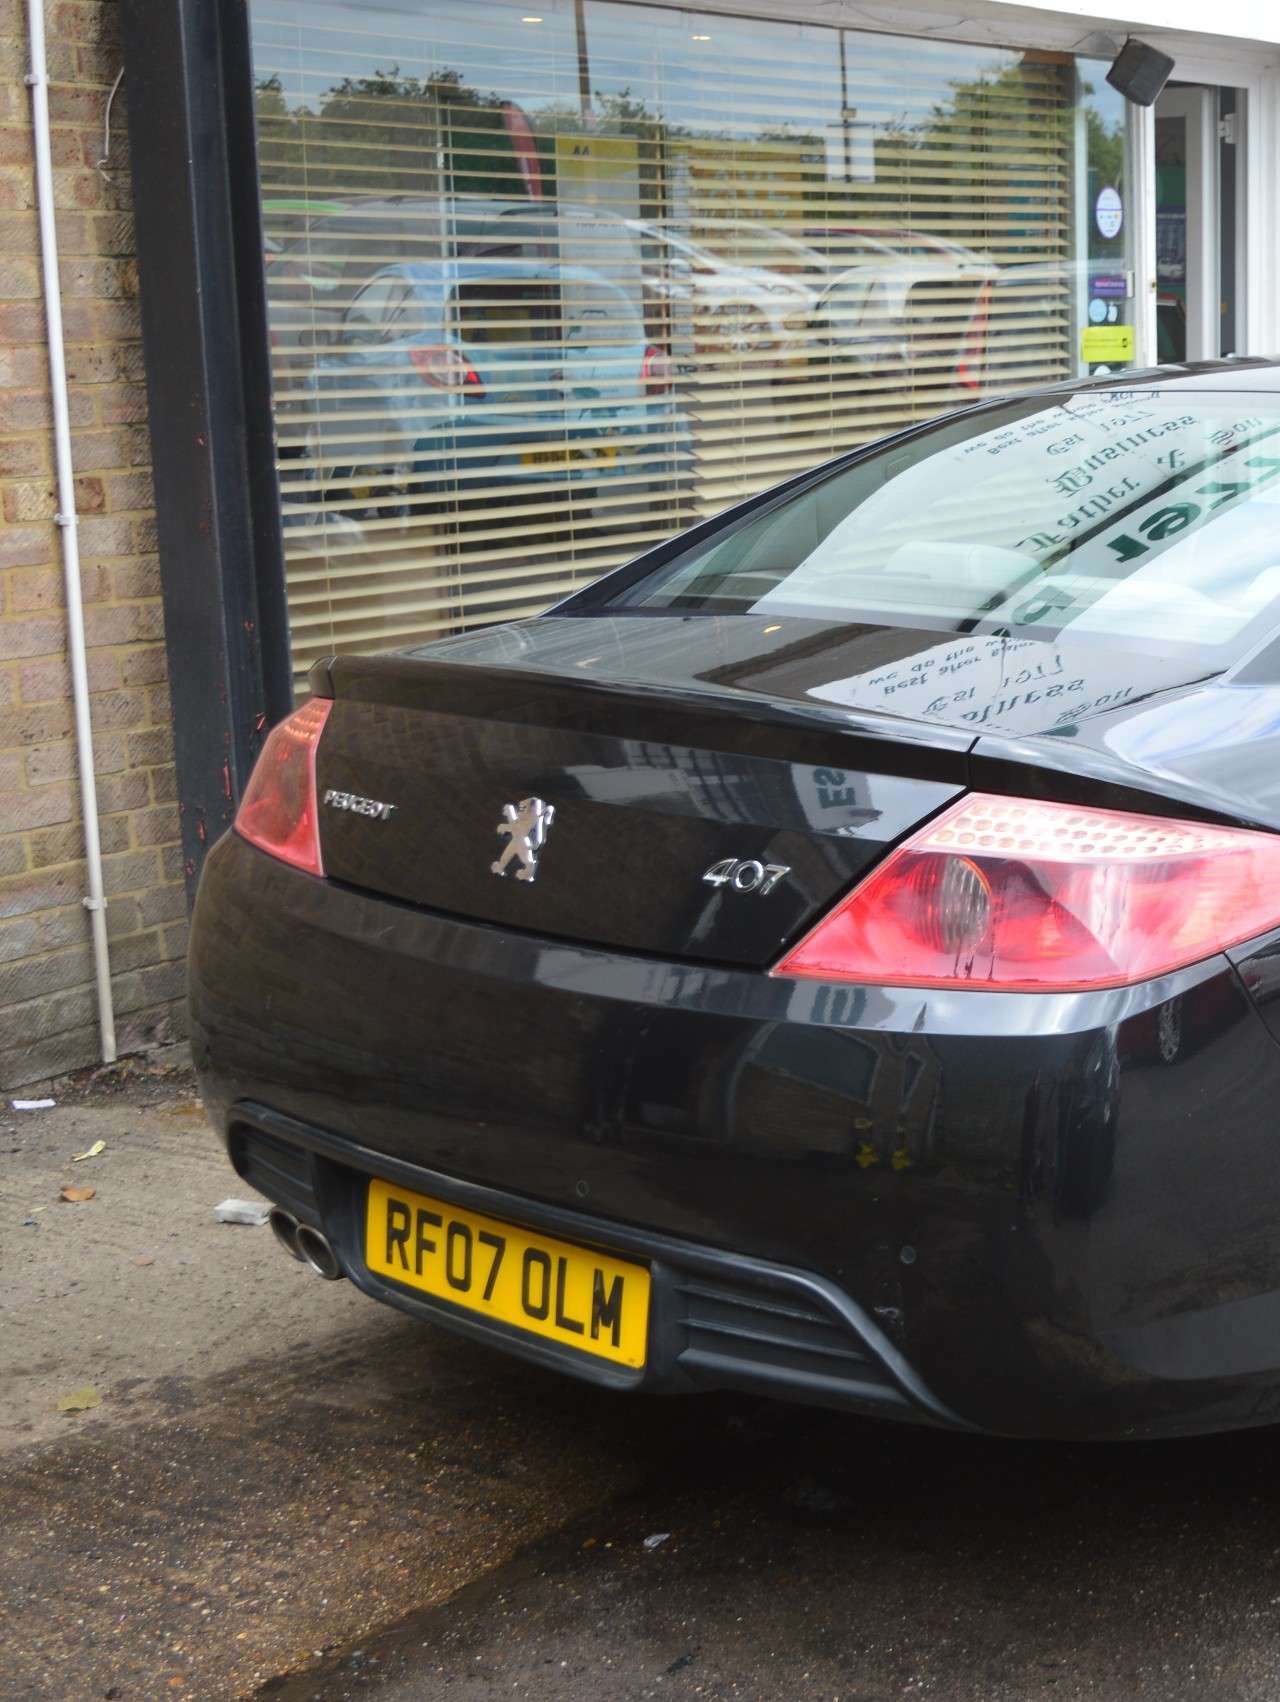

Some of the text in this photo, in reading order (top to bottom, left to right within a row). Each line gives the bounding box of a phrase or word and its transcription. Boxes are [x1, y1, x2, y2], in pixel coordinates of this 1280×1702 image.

[323, 789, 397, 820] PEUGEOT
[702, 858, 791, 895] 407
[386, 1197, 625, 1348] RF07 OLM
